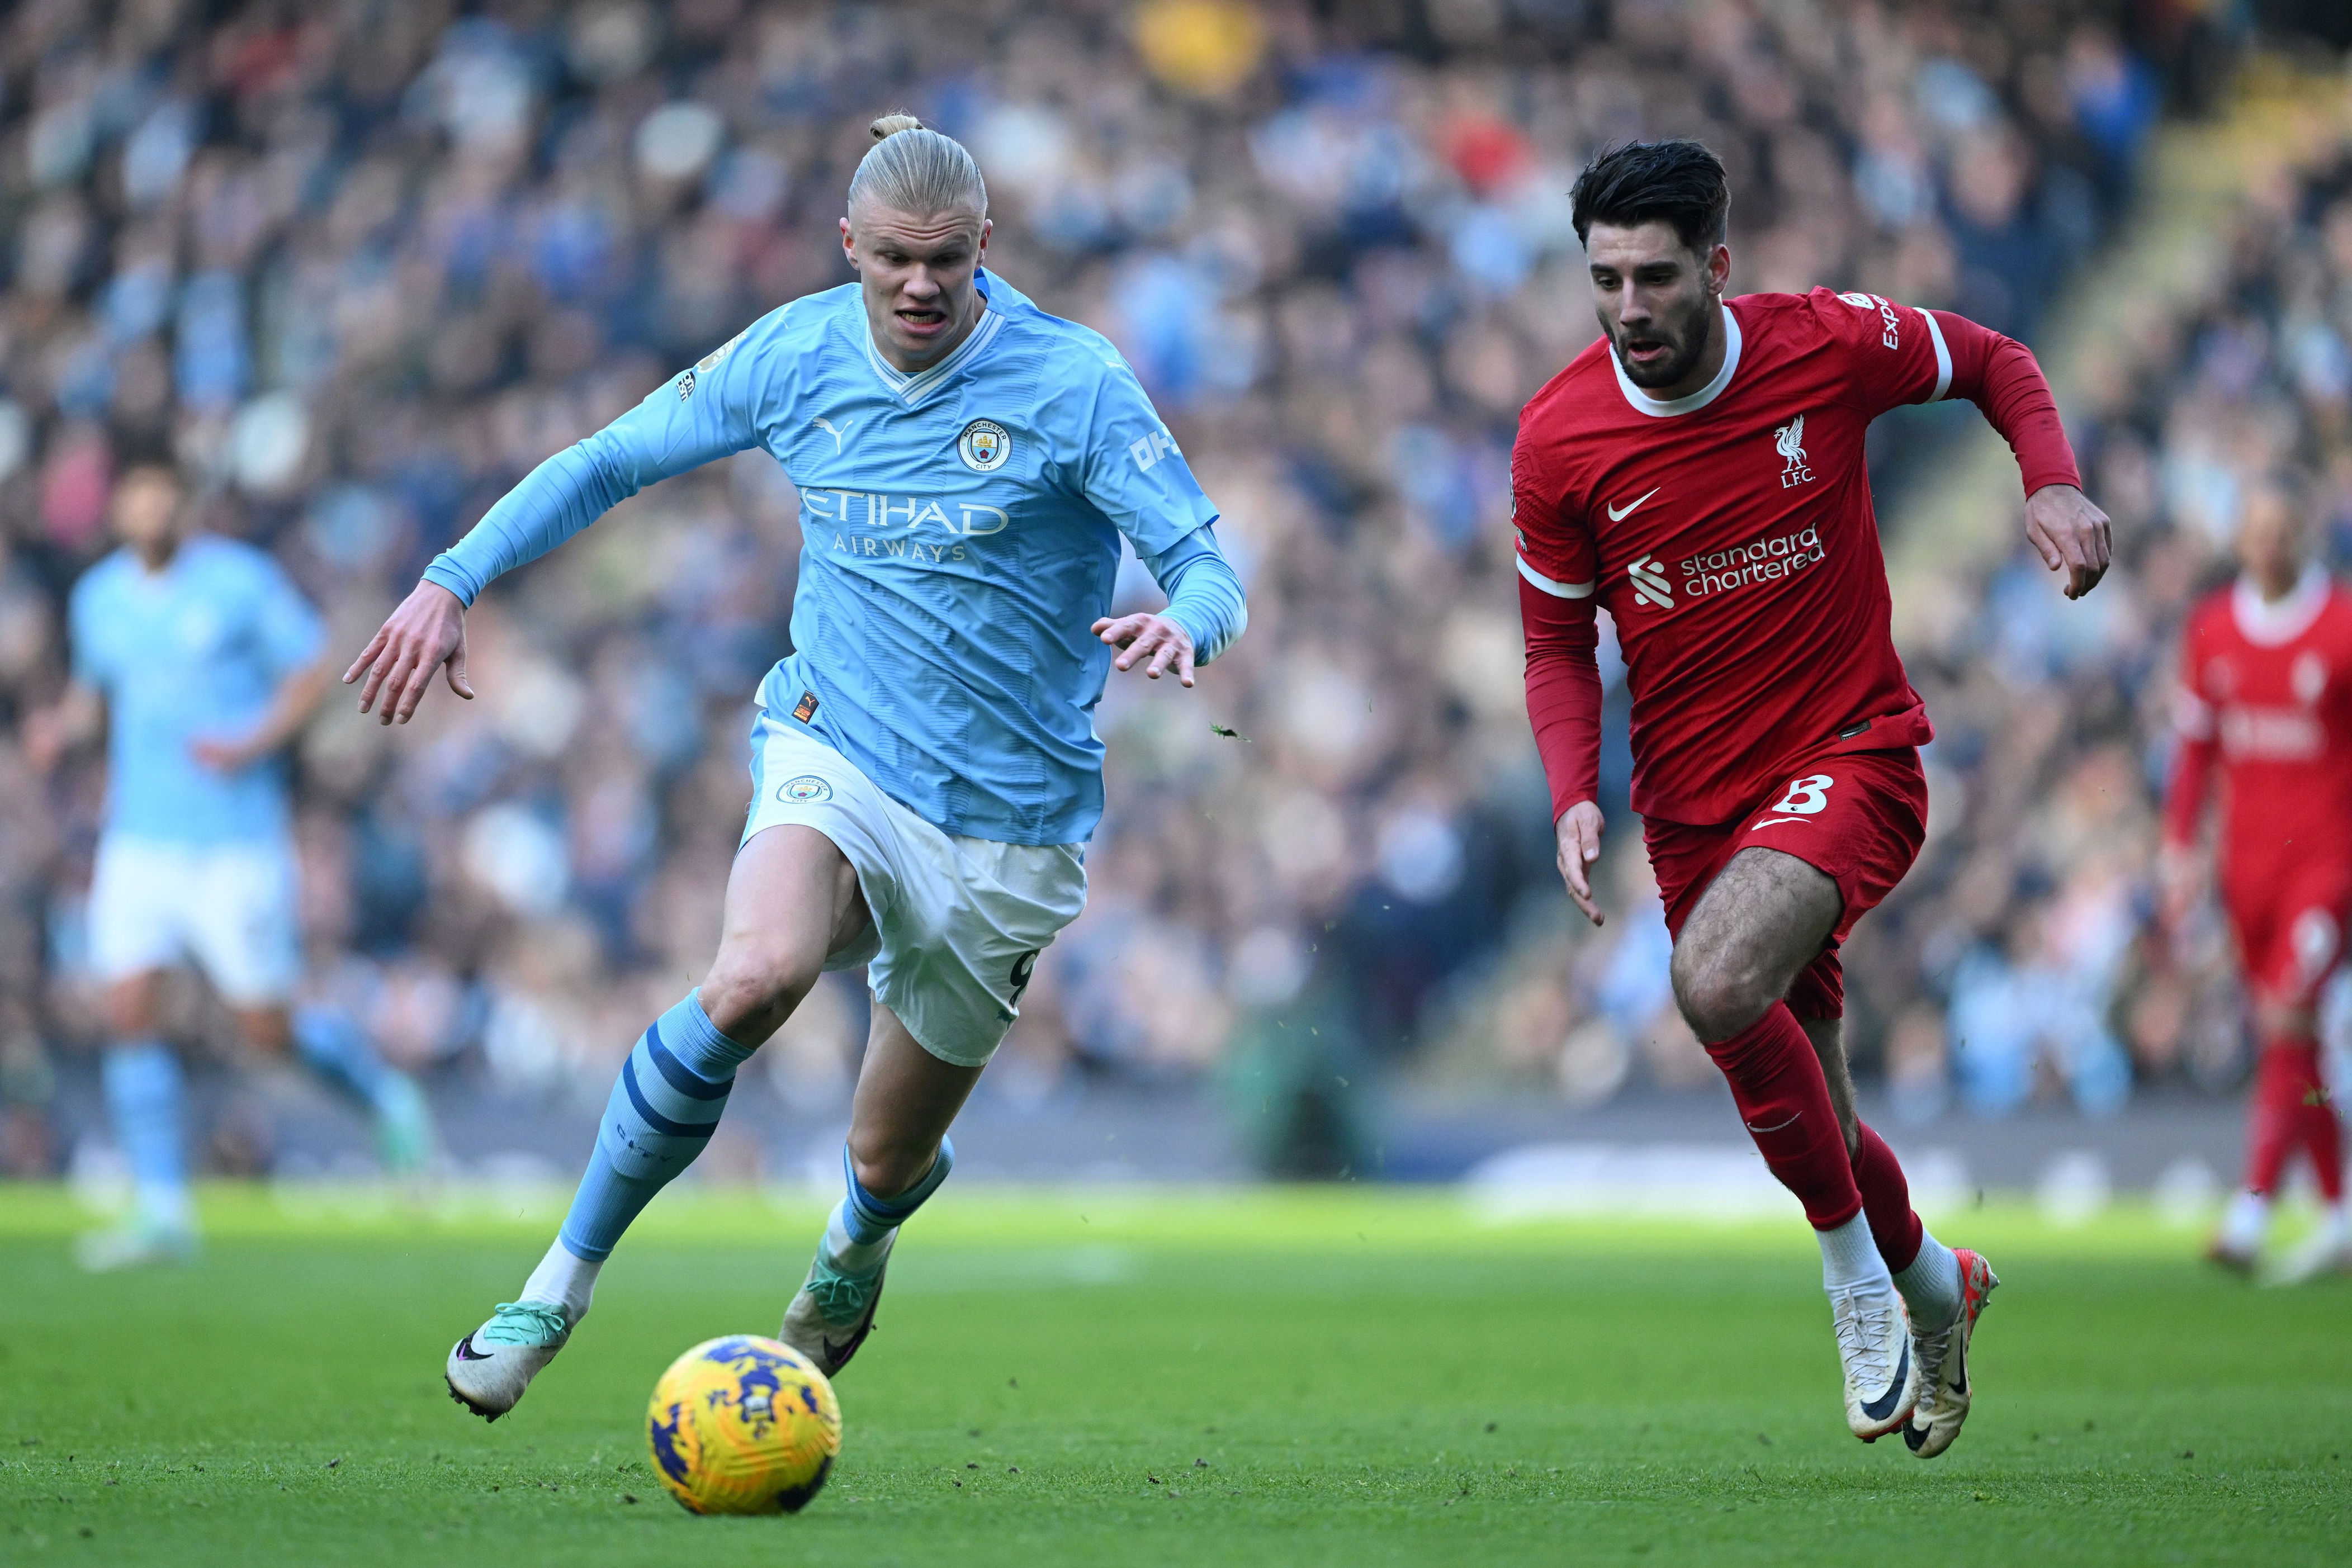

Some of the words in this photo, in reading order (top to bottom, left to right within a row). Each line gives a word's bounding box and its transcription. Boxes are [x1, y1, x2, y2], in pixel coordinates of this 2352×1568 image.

[1869, 293, 1900, 350] Expe
[963, 422, 1007, 440] MANCHESTER
[1781, 468, 1816, 489] L.F.C.
[801, 487, 1009, 535] ETIHAD
[833, 533, 966, 562] AIRWAYS
[1681, 522, 1819, 576] standard
[1686, 538, 1825, 596] chartered
[785, 779, 828, 792] MANCHESTER
[1772, 774, 1834, 814] 8
[1009, 949, 1041, 1008] 9
